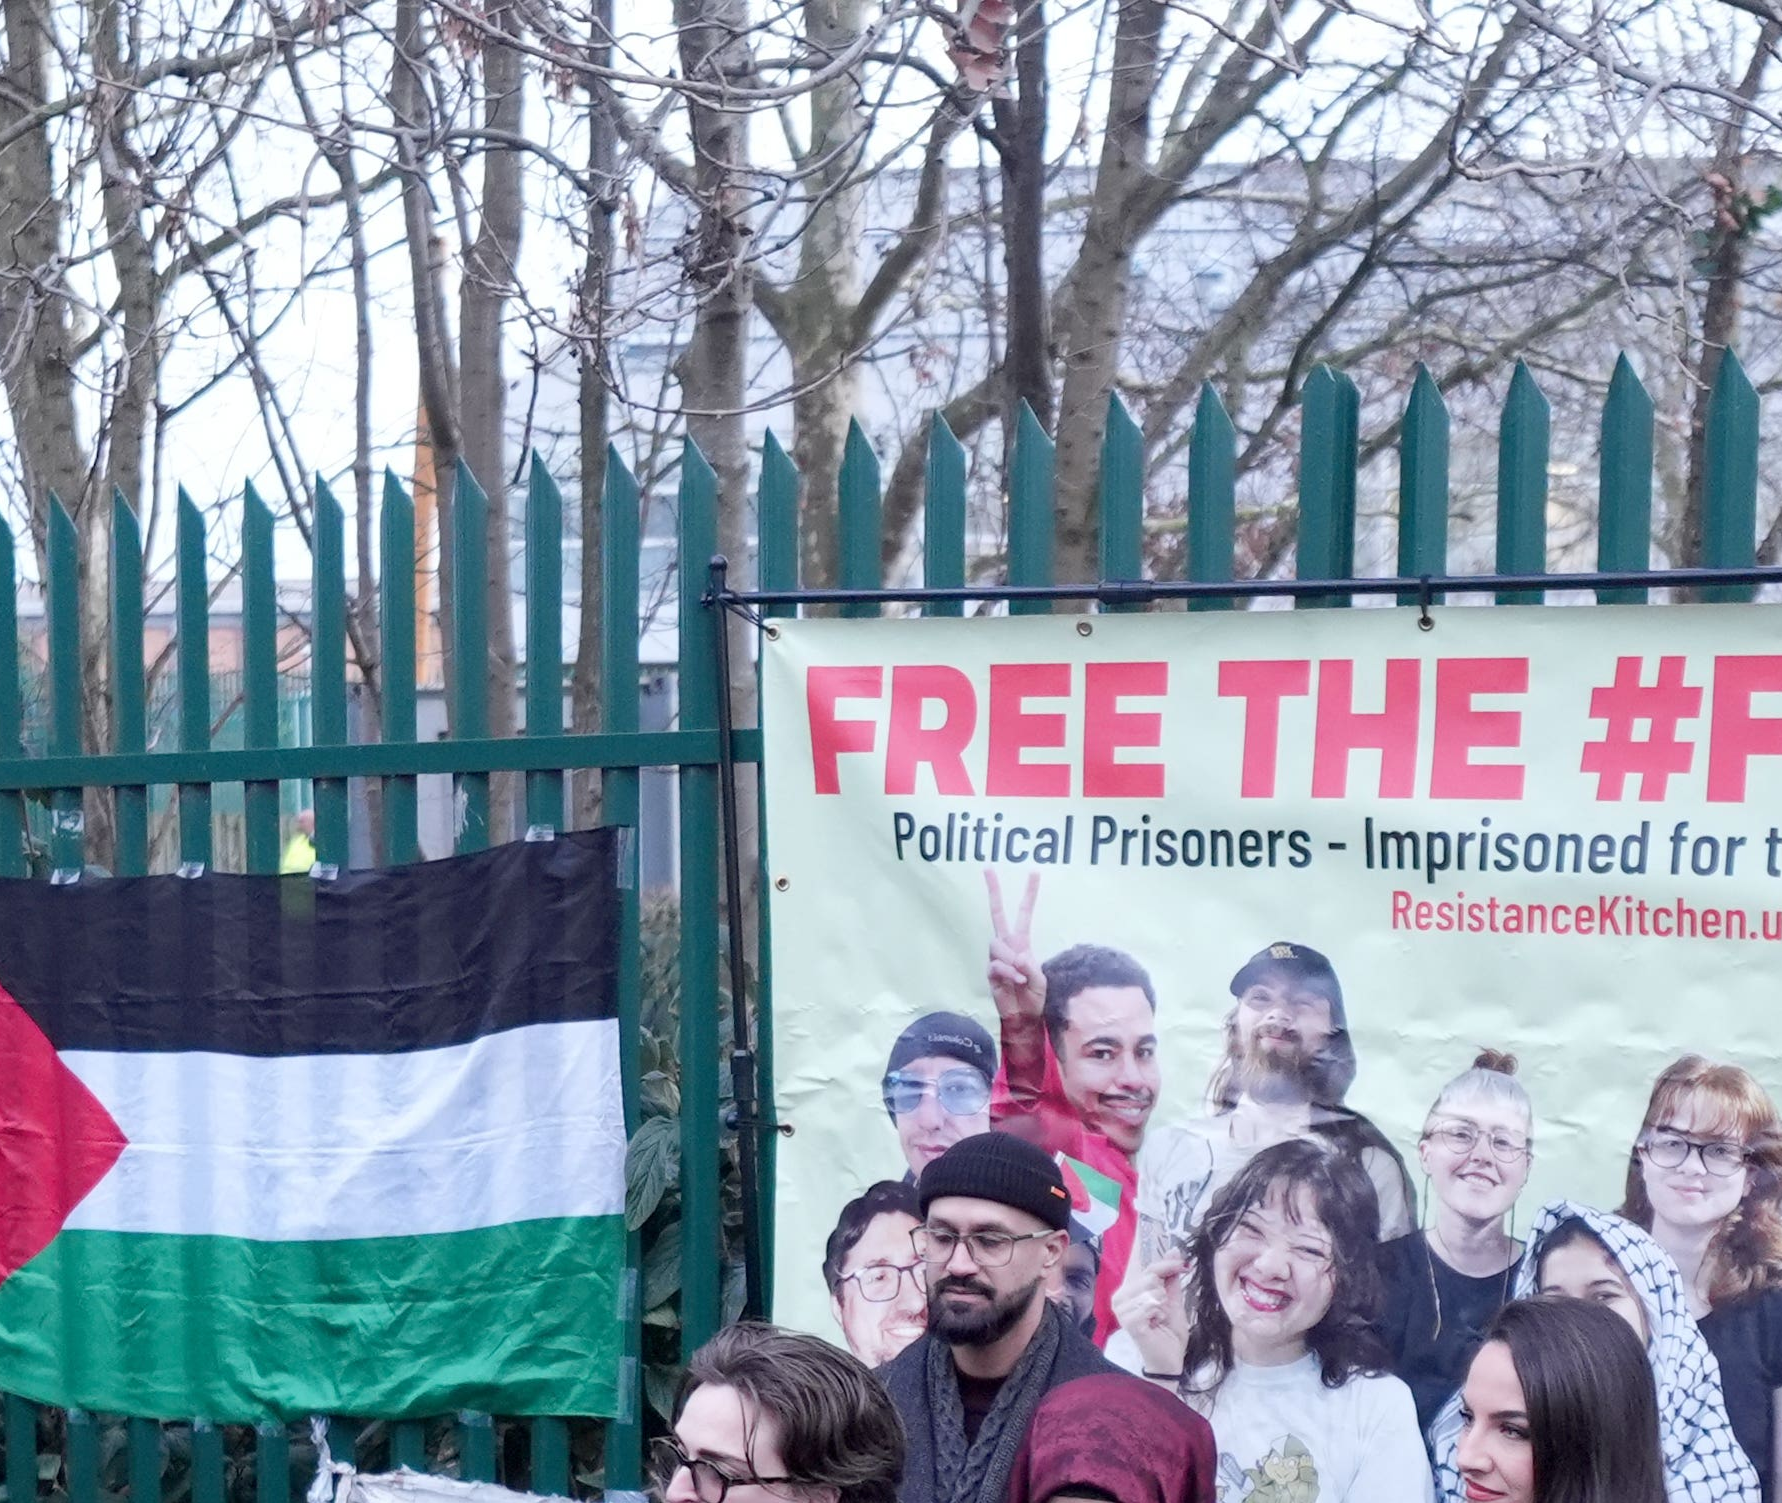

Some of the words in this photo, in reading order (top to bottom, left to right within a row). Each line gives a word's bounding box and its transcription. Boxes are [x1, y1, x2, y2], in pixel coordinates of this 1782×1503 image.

[807, 662, 1168, 798] FREE
[1218, 657, 1529, 800] THE
[893, 811, 1074, 865] Political
[1091, 815, 1313, 868] Prisoners
[1365, 817, 1650, 884] Imprisoned
[1670, 822, 1747, 876] for
